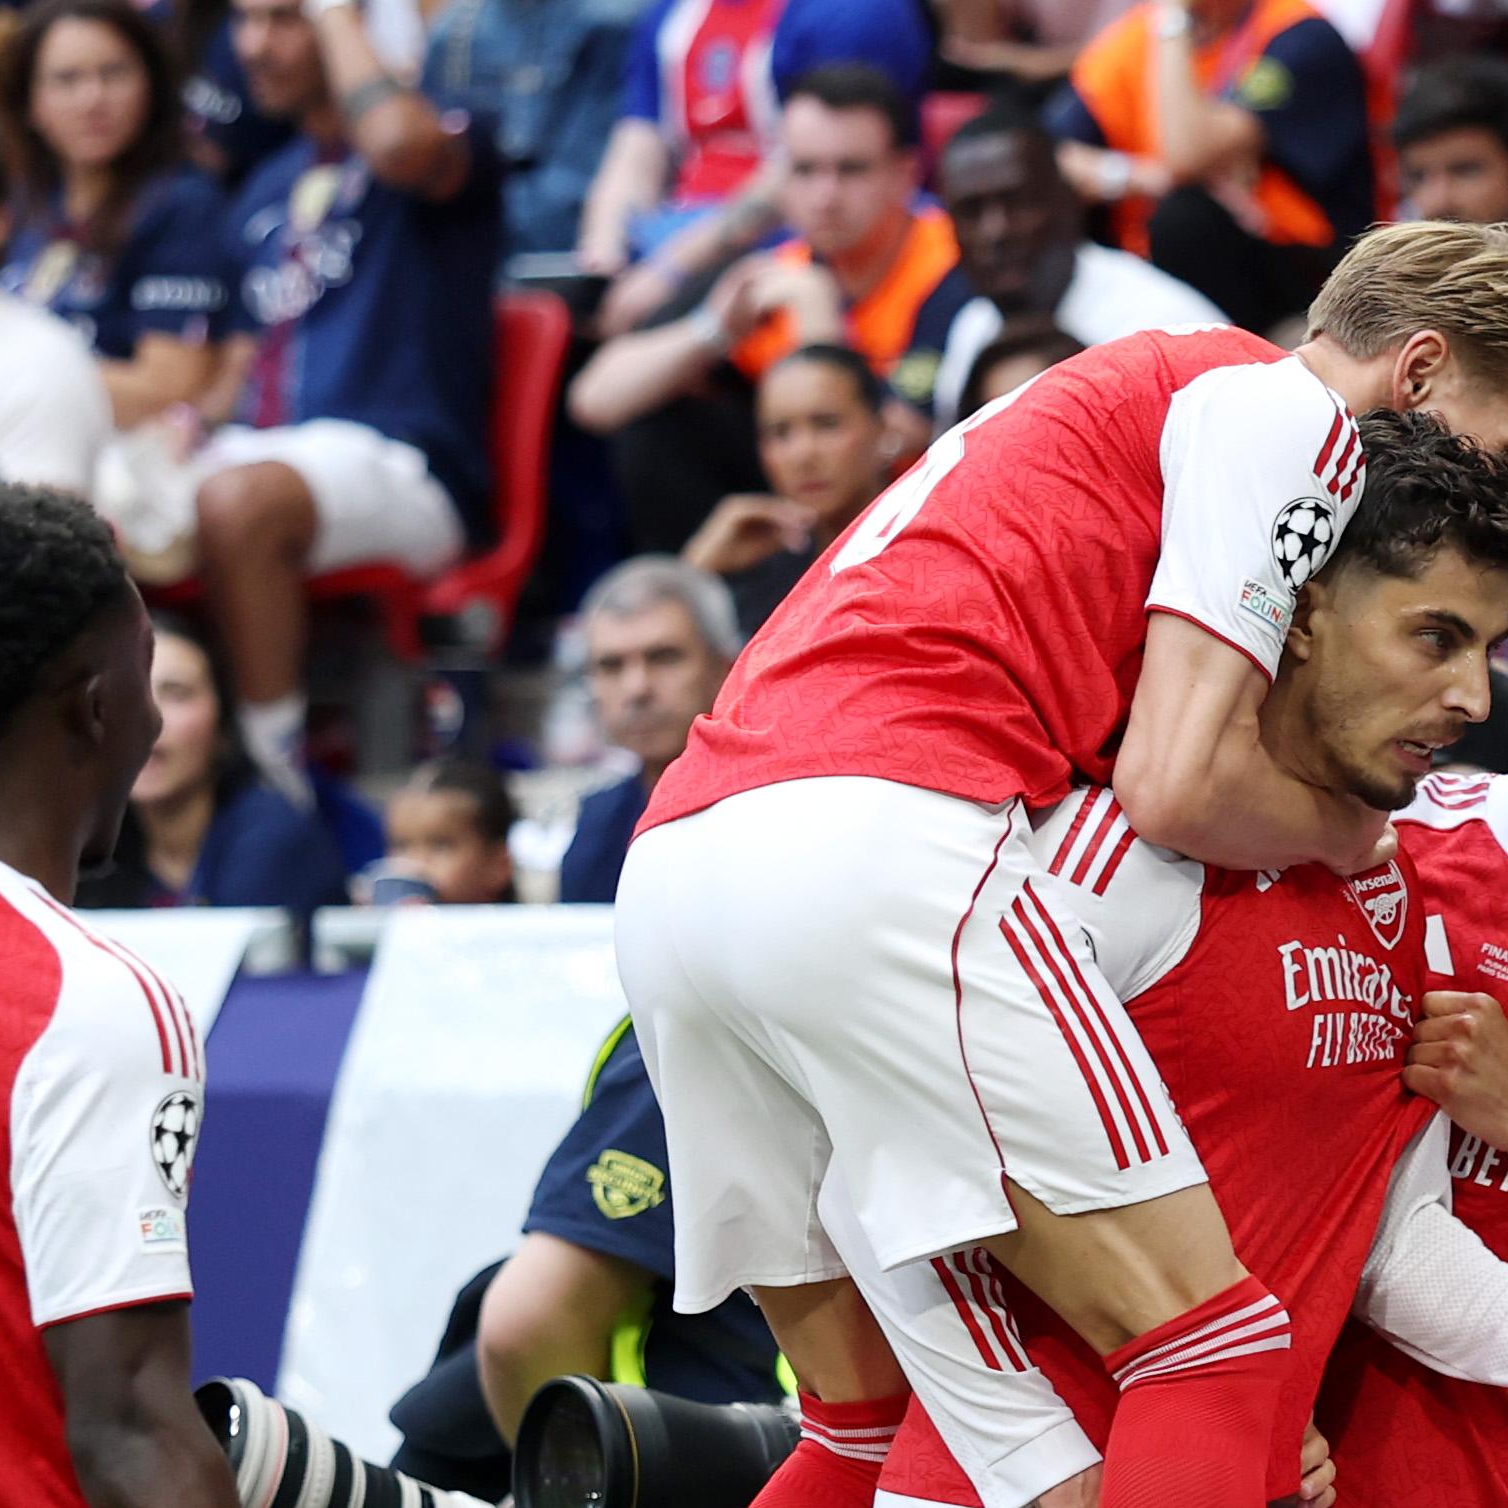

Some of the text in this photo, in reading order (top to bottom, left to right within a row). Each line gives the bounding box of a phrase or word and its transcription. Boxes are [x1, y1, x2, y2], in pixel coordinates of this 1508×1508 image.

[1244, 580, 1267, 596] UEFA
[1353, 870, 1398, 893] Arsenal
[1306, 1012, 1344, 1068] FLY
